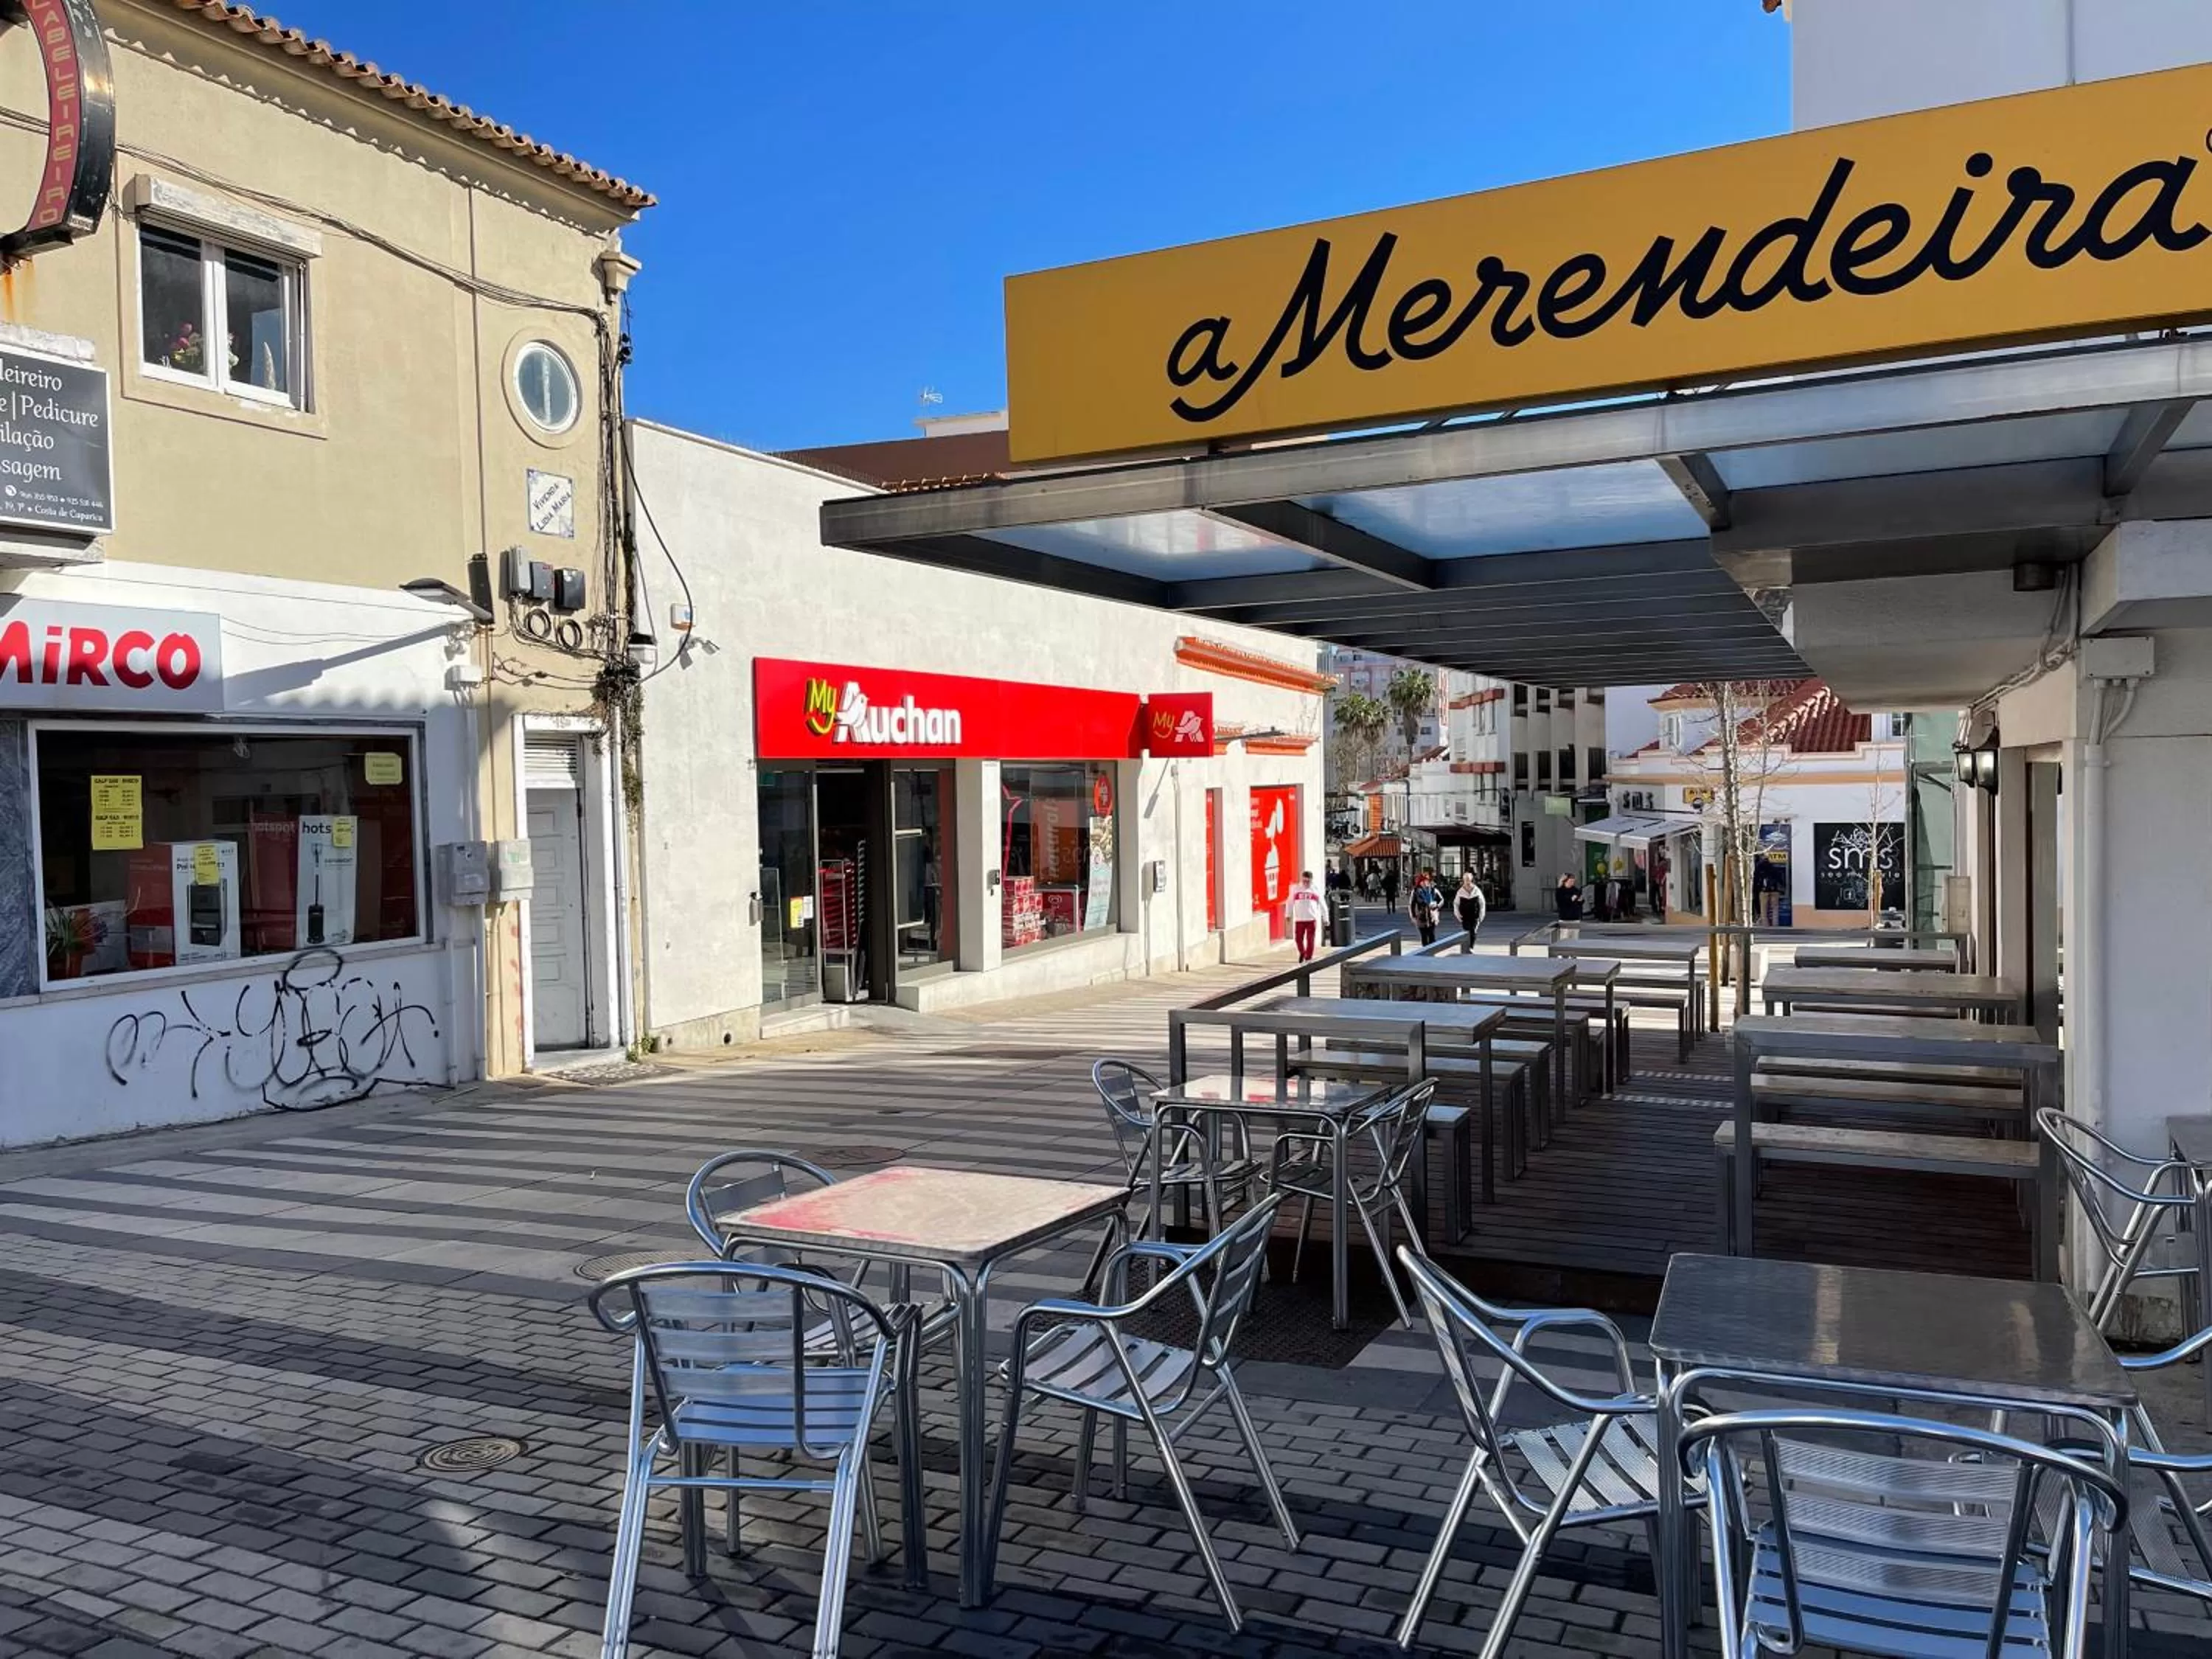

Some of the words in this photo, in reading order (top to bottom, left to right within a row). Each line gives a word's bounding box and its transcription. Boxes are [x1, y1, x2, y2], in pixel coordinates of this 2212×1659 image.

[1169, 152, 2212, 422] Merendeira
[1167, 316, 1239, 388] a
[20, 394, 99, 427] Pedicure
[806, 677, 837, 734] My
[835, 681, 962, 744] Auchan
[1152, 710, 1176, 740] My
[1828, 847, 1893, 869] sms
